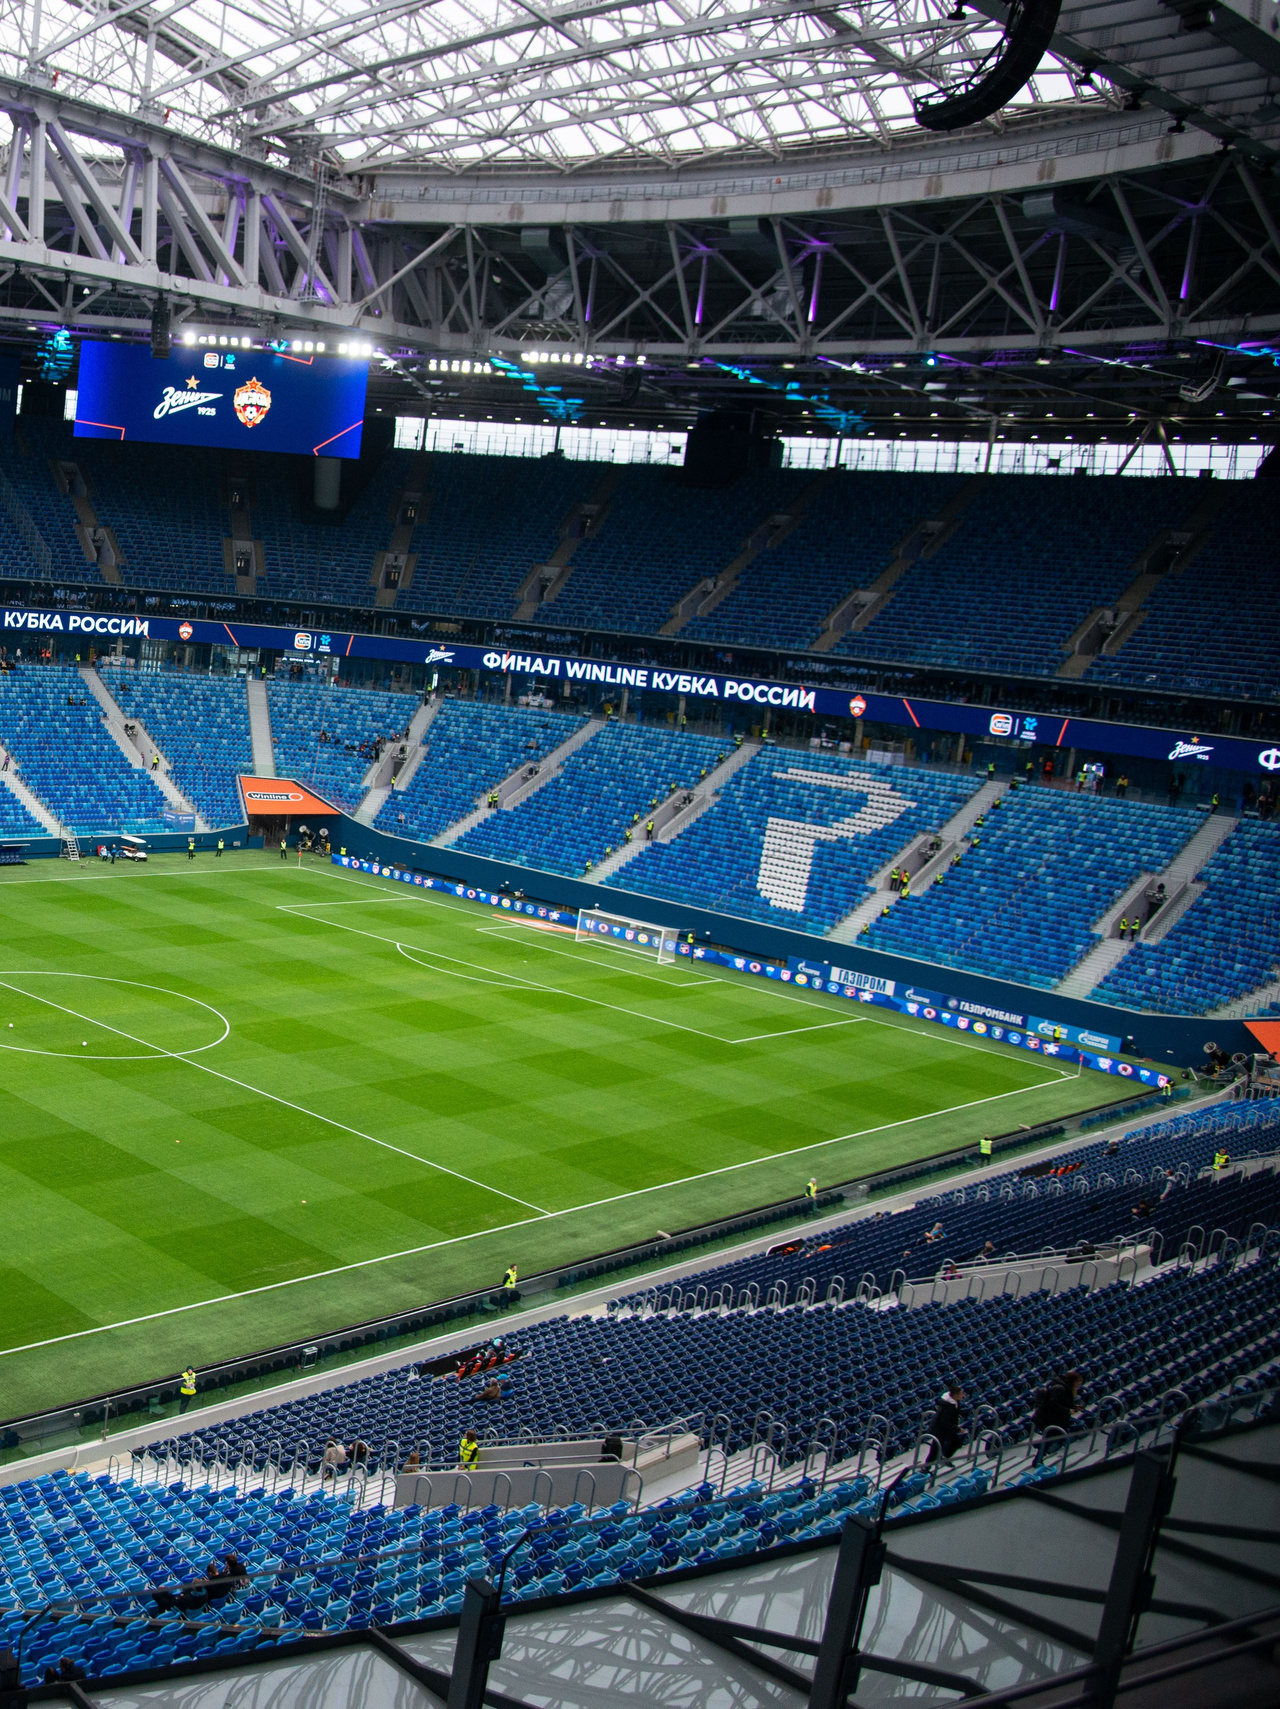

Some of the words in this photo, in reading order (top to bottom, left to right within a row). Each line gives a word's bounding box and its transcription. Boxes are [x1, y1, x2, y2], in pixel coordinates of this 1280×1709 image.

[197, 407, 216, 416] 1925
[4, 611, 64, 631] КУБКА
[68, 615, 149, 636] РОССИИ
[482, 652, 560, 676] ФИНАЛ
[566, 661, 649, 687] WINLINE
[652, 671, 719, 697] КУБКА
[724, 680, 816, 709] РОССИИ
[839, 969, 887, 992] ГАЗПРОМ
[959, 1001, 1023, 1026] ГАЗПРОМБАНК
